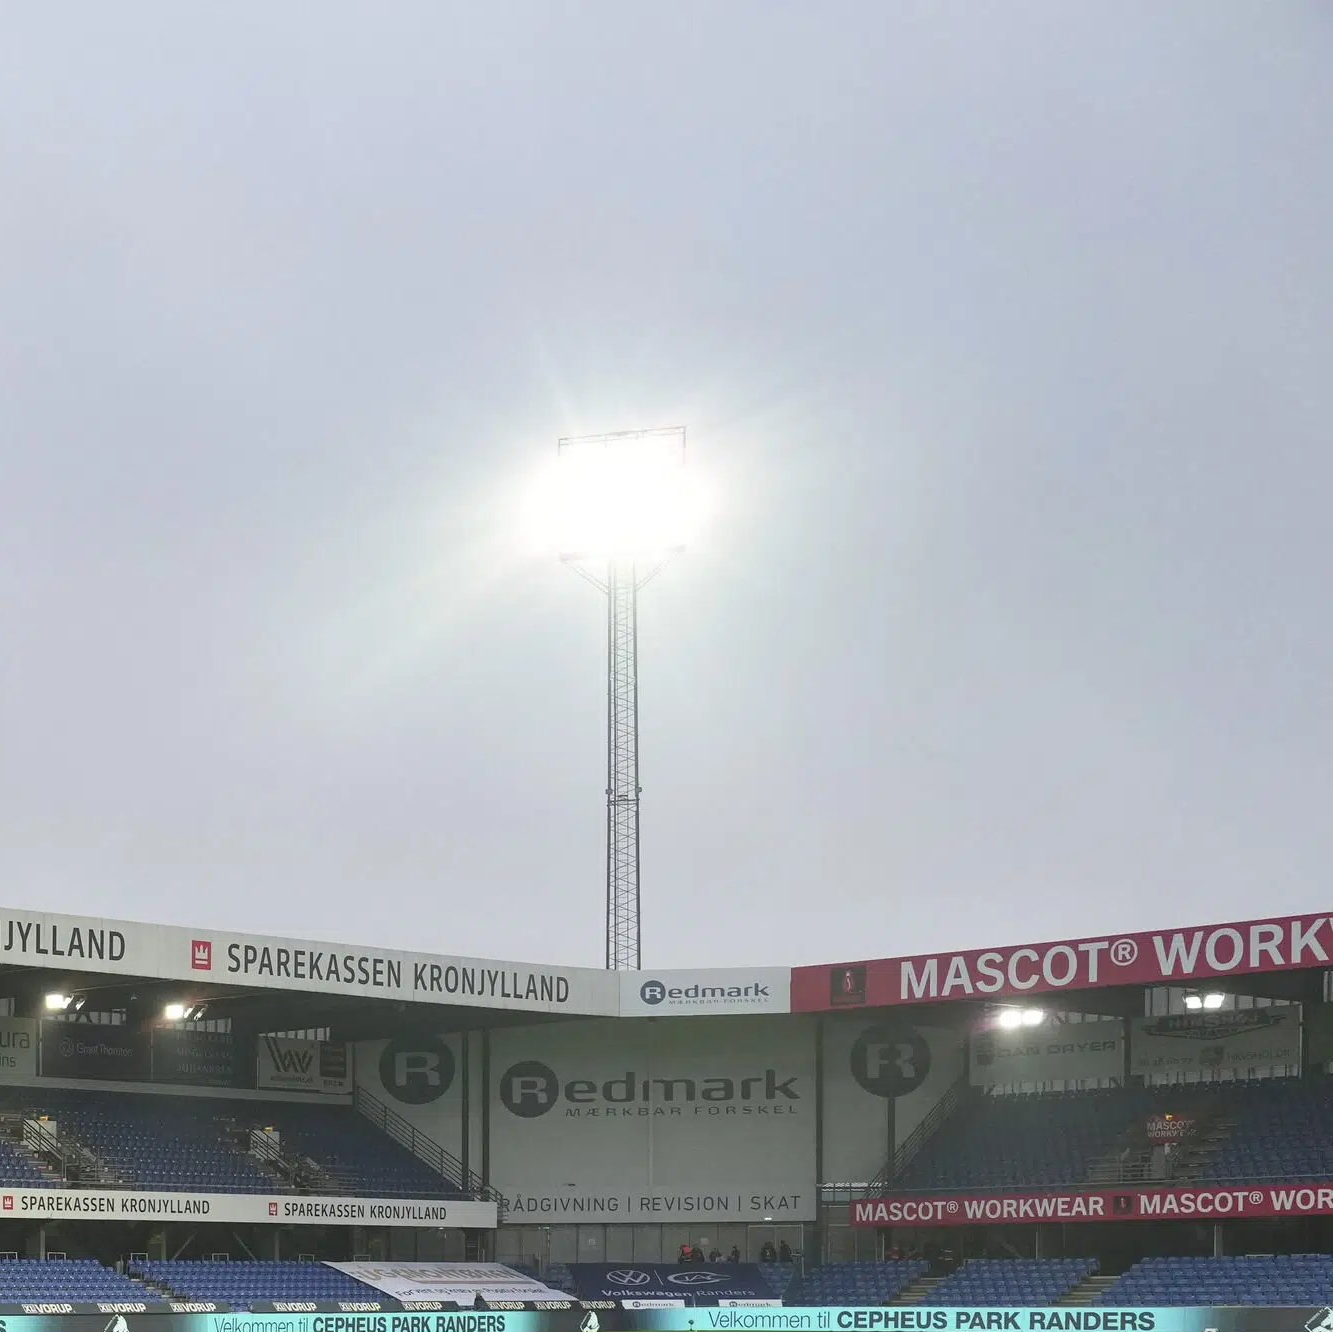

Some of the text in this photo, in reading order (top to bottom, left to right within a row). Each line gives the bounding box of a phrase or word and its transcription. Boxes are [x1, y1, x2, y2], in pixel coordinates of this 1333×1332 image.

[900, 918, 1333, 1000] MASCOT® WORK
[227, 943, 570, 1003] SPAREKASSEN KRONJYLLAND
[642, 981, 770, 1004] Redmark
[502, 1063, 801, 1112] Redmark
[565, 1105, 799, 1117] MÆRKBAR FORSKEL
[21, 1194, 210, 1215] SPAREKASSEN KRONJYLLAND
[502, 1194, 802, 1213] RÅDGIVNING REVISION SKAT
[965, 1196, 1104, 1220] WORKWEAR
[284, 1201, 447, 1221] SPAREKASSEN KRONJYLLAND
[600, 1288, 757, 1298] Volkswagen Randers
[35, 1303, 73, 1313] VORUP
[111, 1303, 147, 1313] VORUP
[182, 1302, 217, 1312] VORUP
[284, 1302, 317, 1312] VORUP
[350, 1302, 381, 1311] VORUP
[414, 1301, 443, 1311] VORUP
[498, 1301, 525, 1310] VORUP
[544, 1301, 571, 1310] VORUP
[590, 1301, 616, 1310] VORUP
[708, 1310, 1156, 1331] Velkommen til CEPHEUS PARK RANDERS
